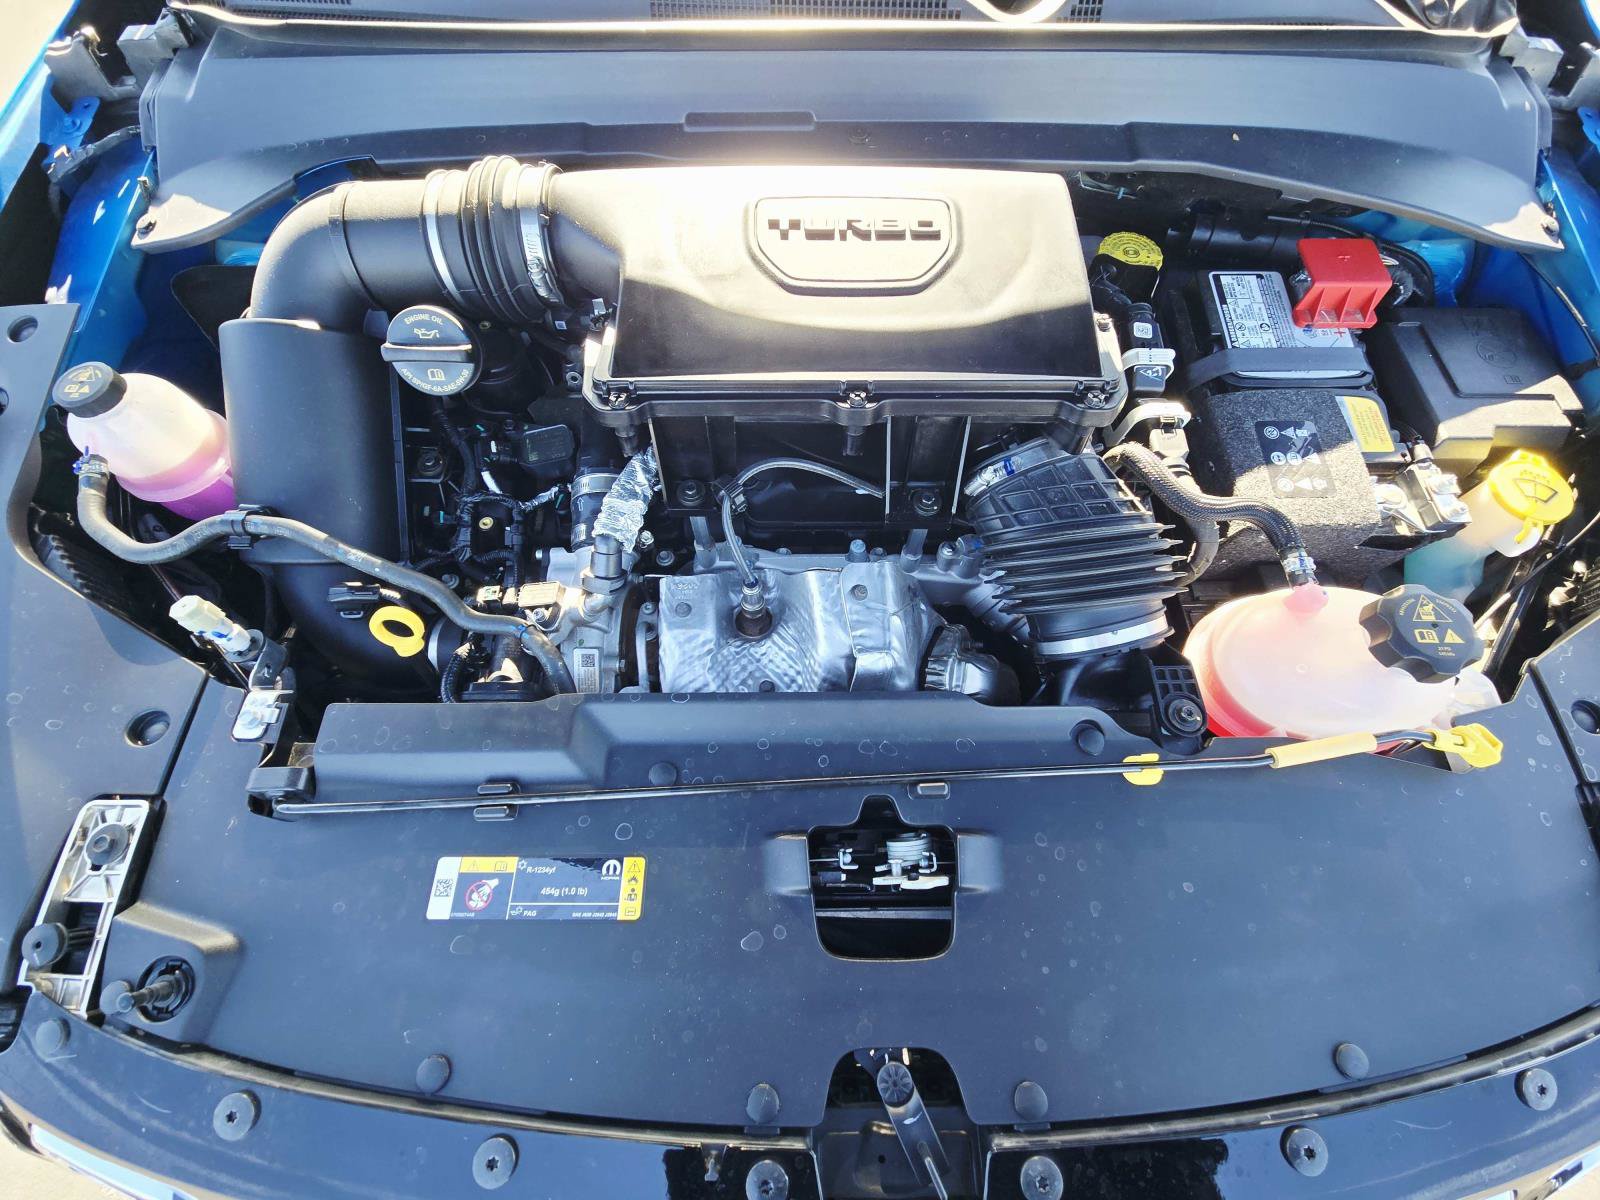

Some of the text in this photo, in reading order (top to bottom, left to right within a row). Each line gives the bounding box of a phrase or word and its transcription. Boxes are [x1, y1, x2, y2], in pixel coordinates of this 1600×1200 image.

[765, 214, 942, 242] TURBO
[404, 314, 444, 325] ENGINE OIL
[401, 369, 413, 380] API
[526, 866, 556, 875] R-1234yf
[540, 887, 588, 897] 454g (1.0 lb)
